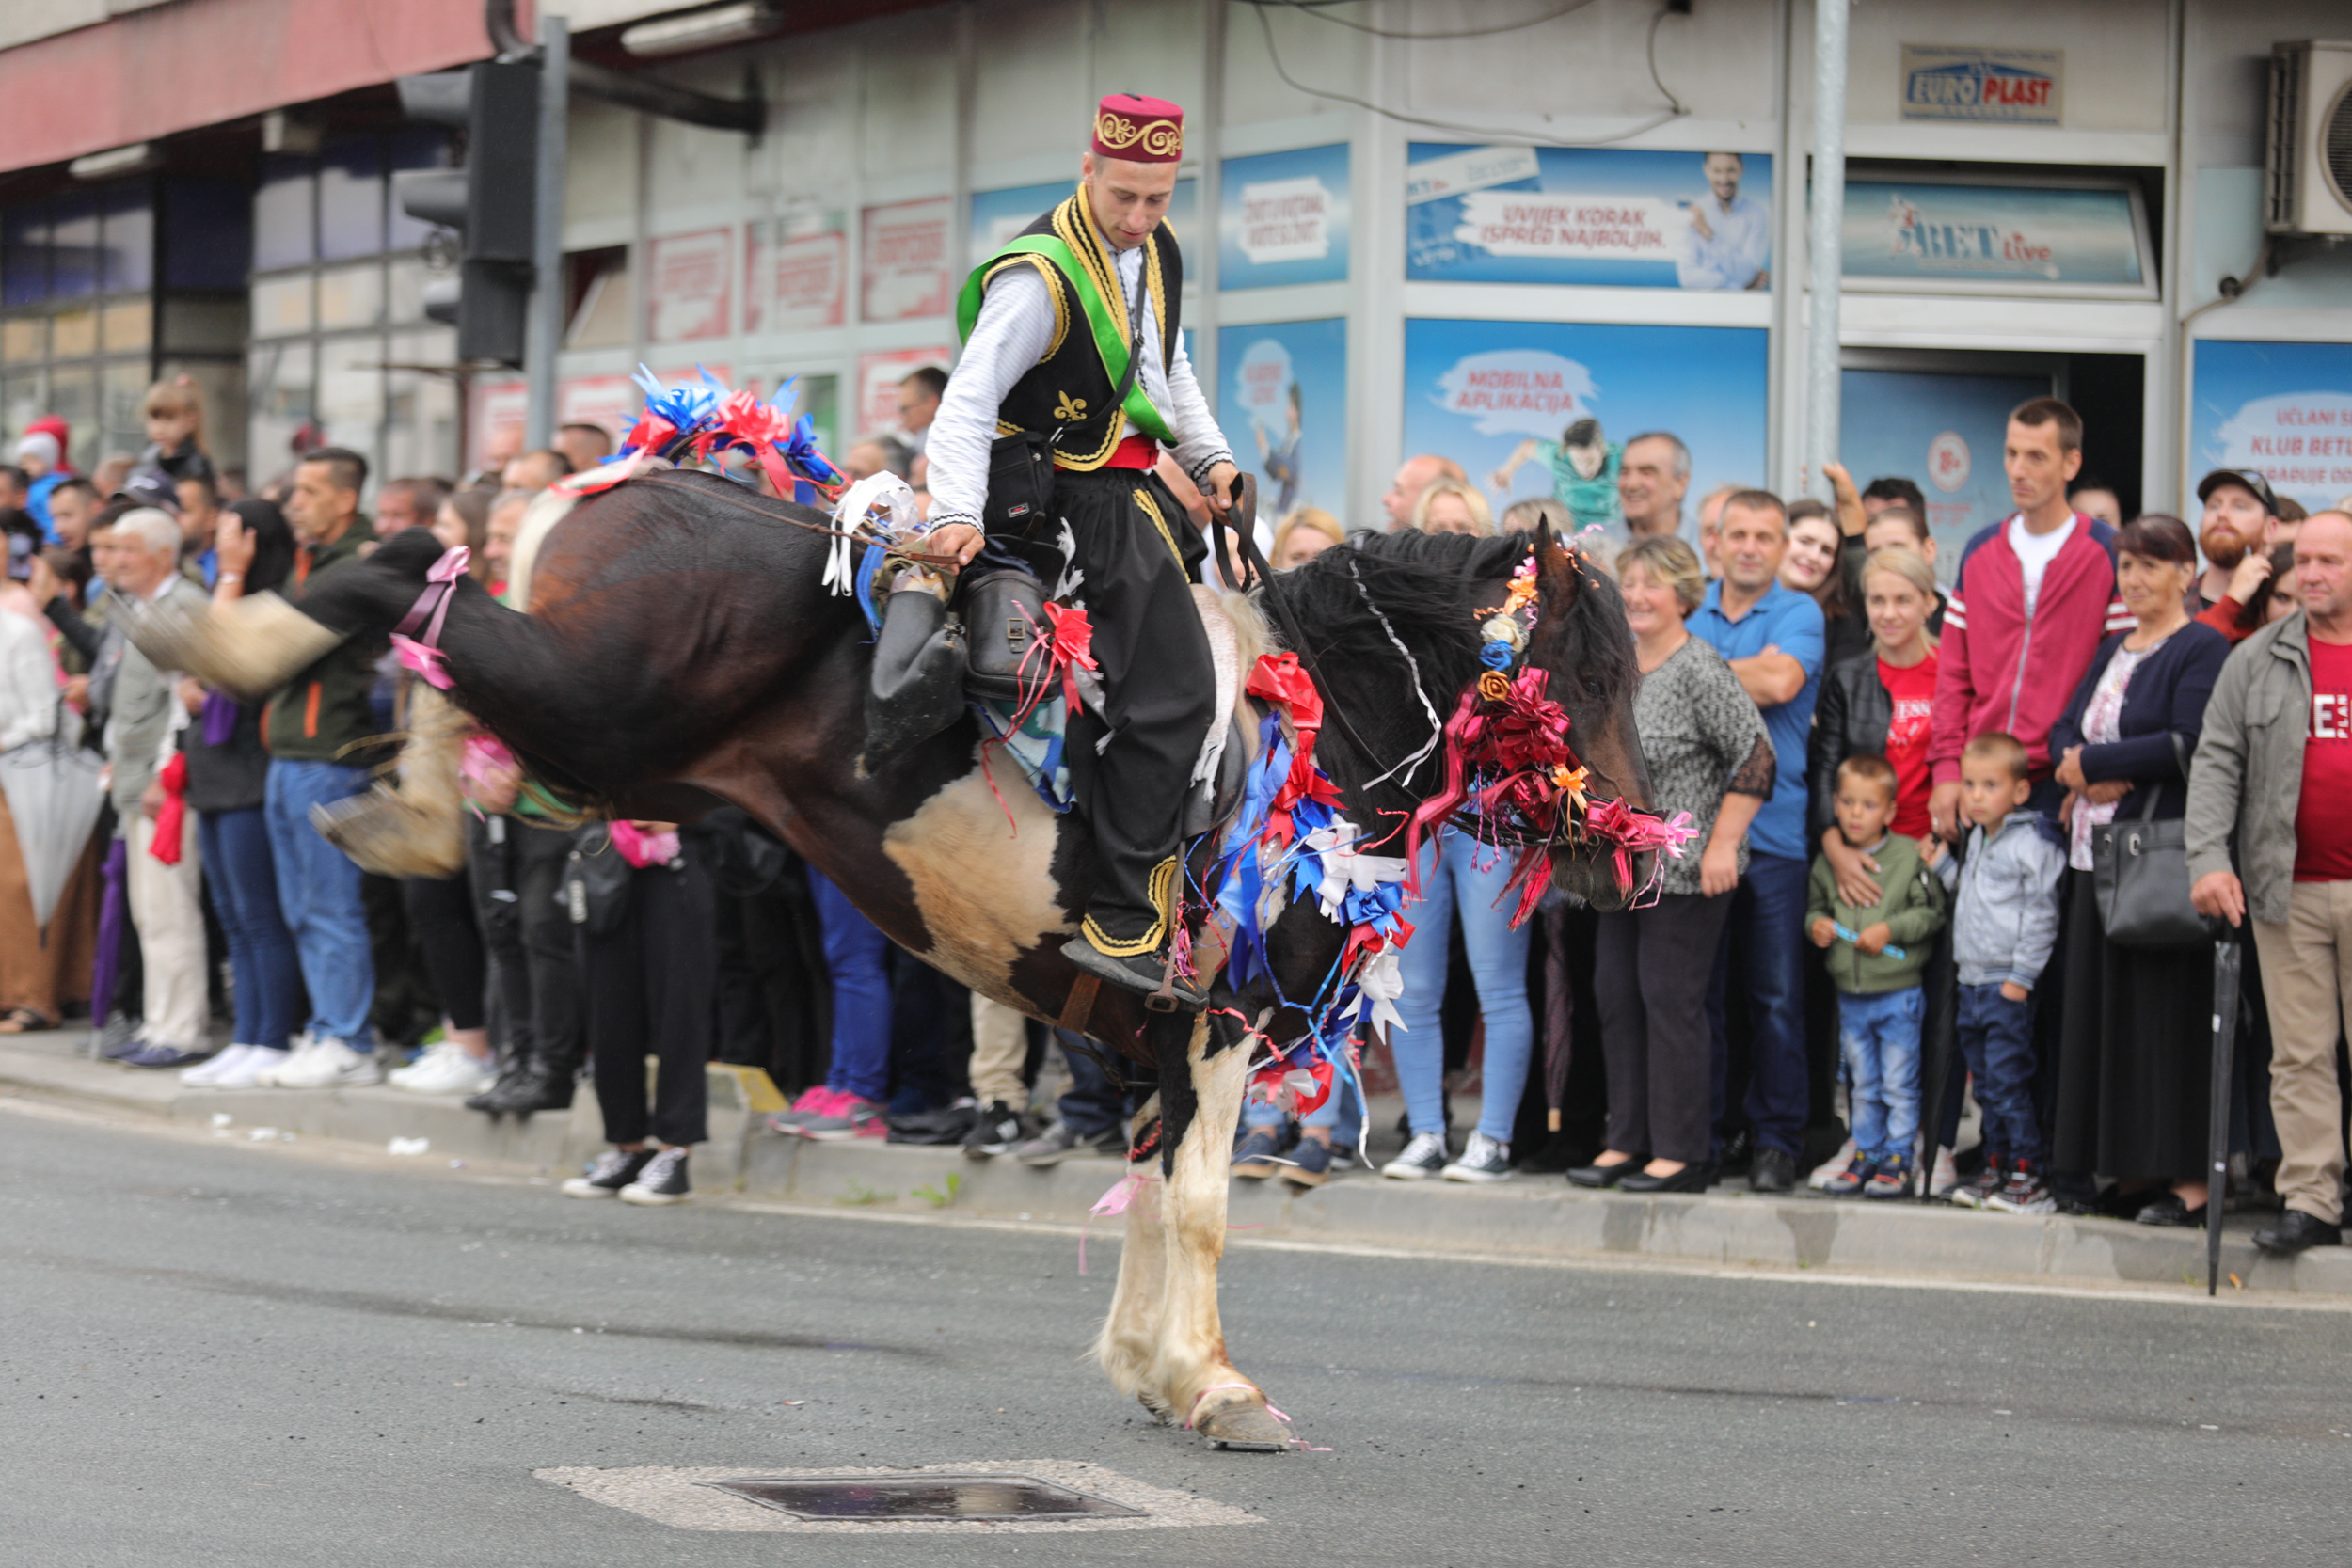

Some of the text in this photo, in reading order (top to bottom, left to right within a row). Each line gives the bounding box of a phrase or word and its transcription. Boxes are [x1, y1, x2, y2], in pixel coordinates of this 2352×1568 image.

[1911, 73, 2053, 107] EURO PLAST
[1502, 205, 1646, 227] UVIJEK KORAK
[1480, 224, 1555, 245] ISPRED
[1467, 370, 1564, 390] MOBILNA
[1456, 391, 1574, 416] APLIKACIJA
[2250, 435, 2303, 457] KLUB
